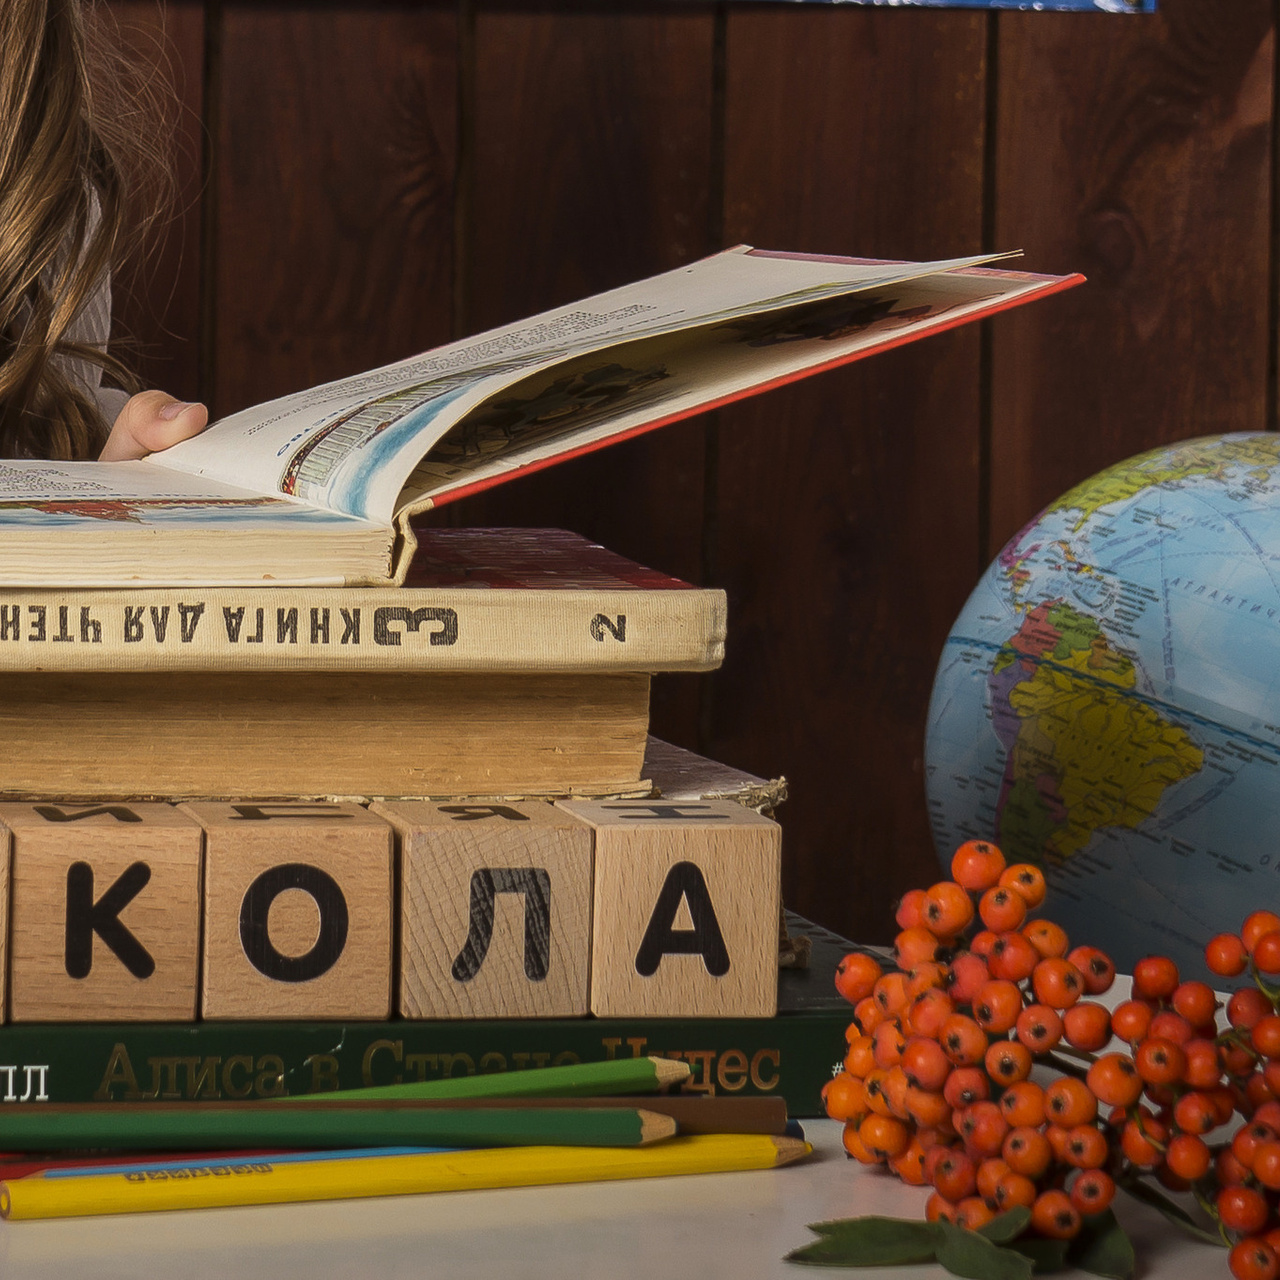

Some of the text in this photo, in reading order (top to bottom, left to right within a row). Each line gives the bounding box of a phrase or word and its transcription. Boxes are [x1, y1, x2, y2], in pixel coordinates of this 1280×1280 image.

[124, 602, 206, 643] ДЛЯ
[222, 606, 361, 644] КНИГА
[590, 613, 626, 642] 2
[94, 1042, 290, 1101] Алиса
[310, 1054, 340, 1094] в
[602, 1037, 781, 1097] дес
